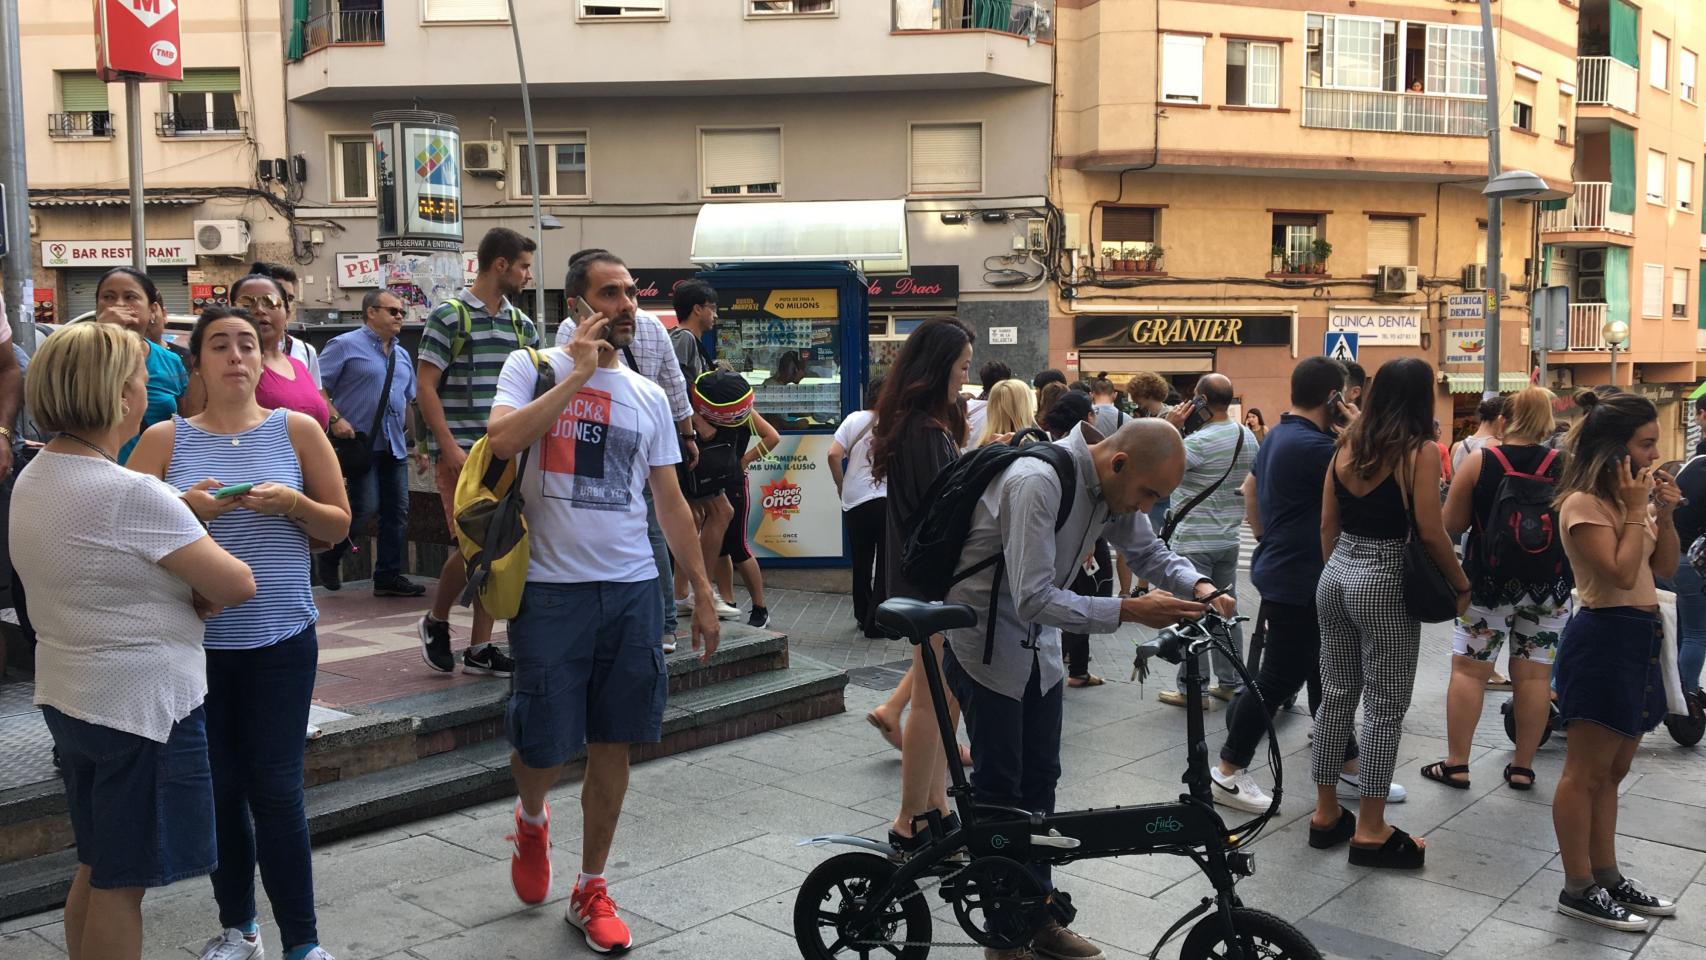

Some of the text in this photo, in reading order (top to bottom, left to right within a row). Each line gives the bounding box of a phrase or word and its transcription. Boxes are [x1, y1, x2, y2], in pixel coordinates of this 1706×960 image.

[156, 48, 175, 59] TMB
[396, 240, 426, 248] RESERVAT
[72, 247, 181, 259] BAR RESTRANT
[891, 277, 943, 295] Dracs
[786, 302, 820, 310] MILIONS
[1450, 296, 1482, 305] CLINICA
[1450, 309, 1481, 317] DENTAL
[1332, 315, 1417, 328] CLINICA DENTAL
[1131, 318, 1243, 346] GRANIER
[563, 399, 605, 423] ACK&
[551, 417, 602, 444] JONES
[763, 495, 801, 508] Once
